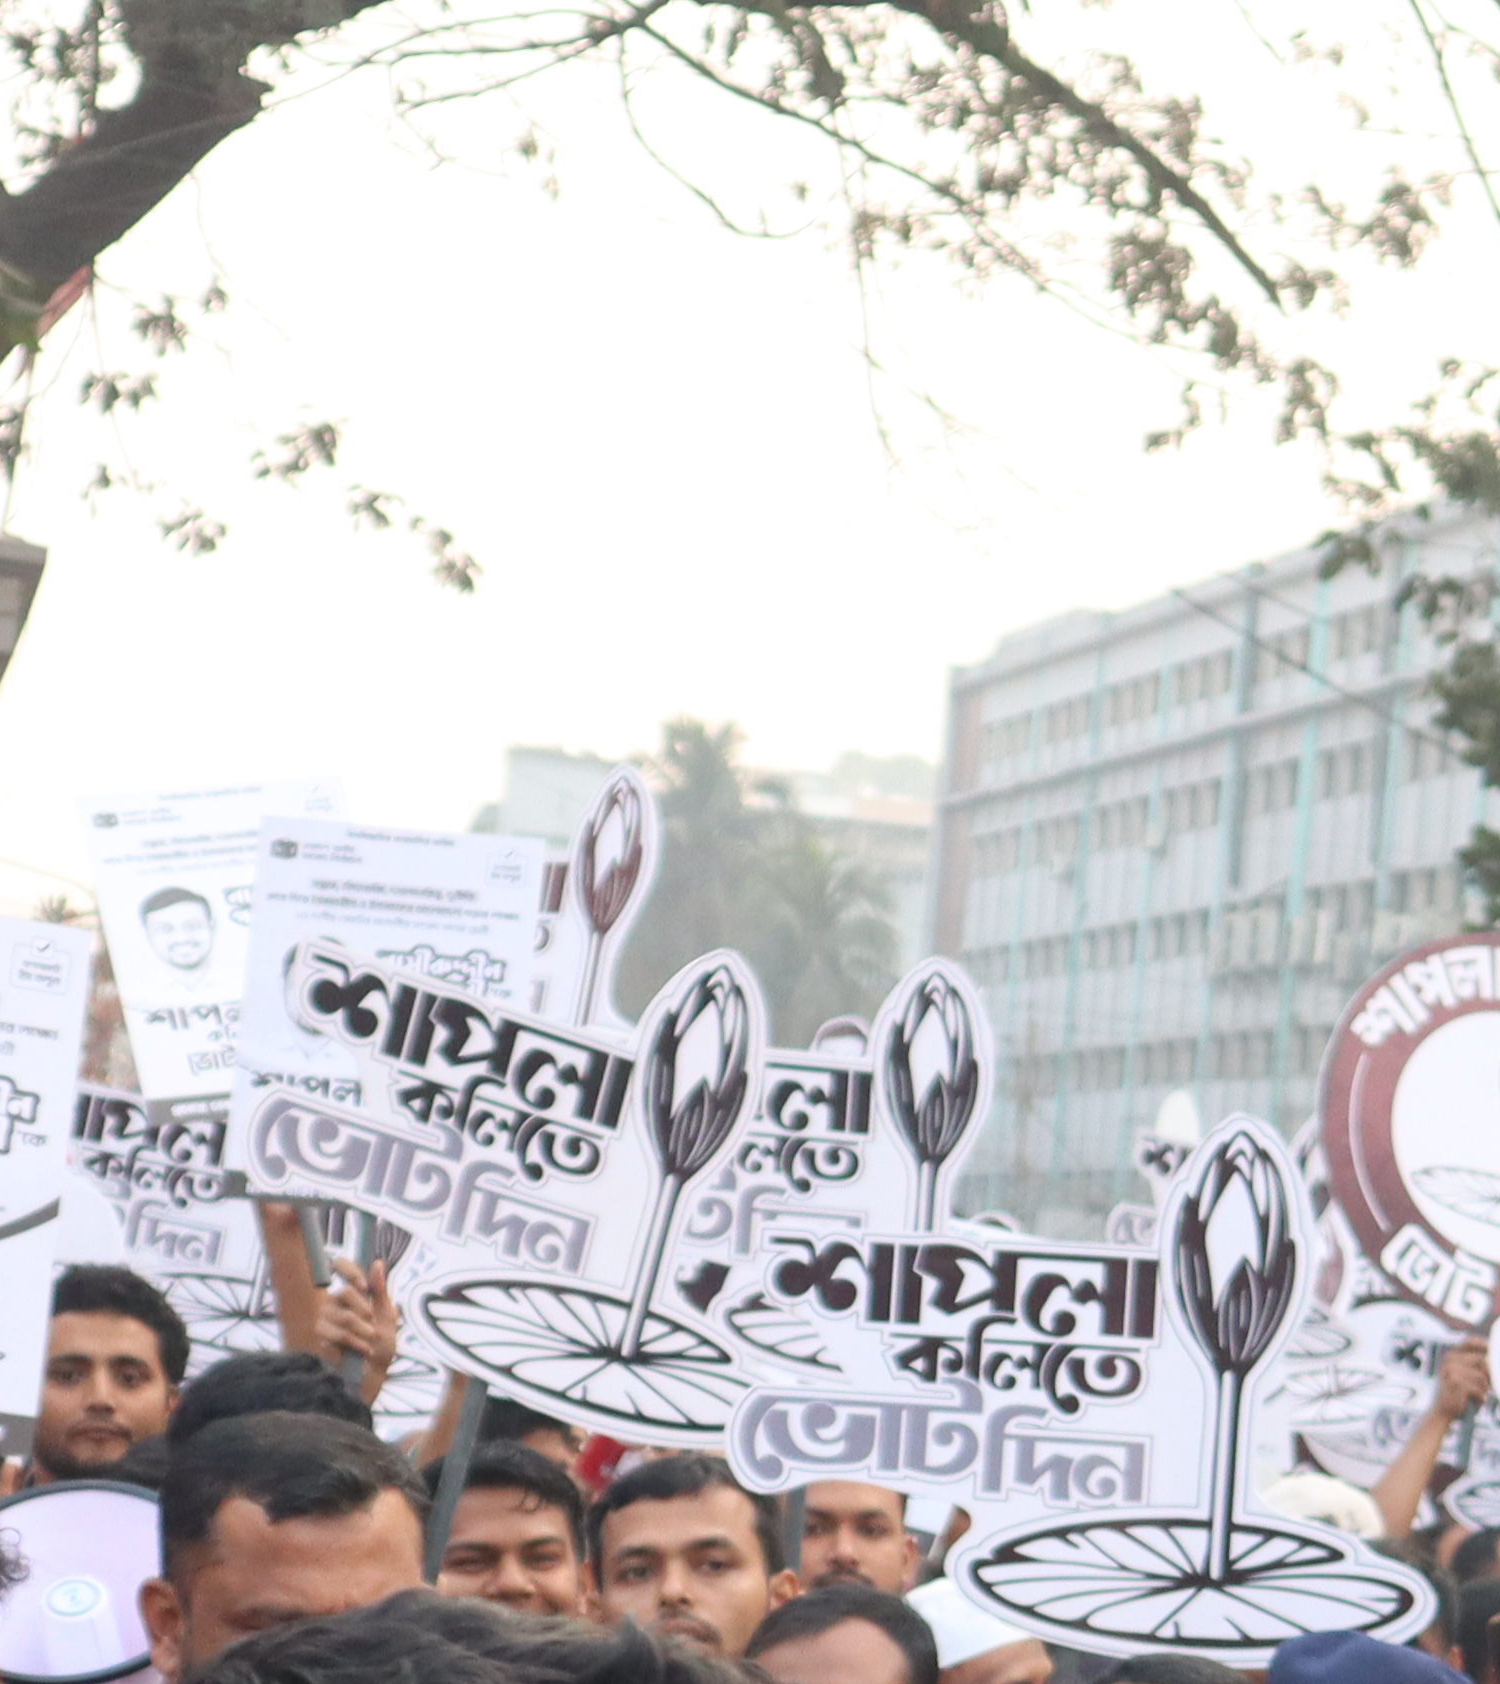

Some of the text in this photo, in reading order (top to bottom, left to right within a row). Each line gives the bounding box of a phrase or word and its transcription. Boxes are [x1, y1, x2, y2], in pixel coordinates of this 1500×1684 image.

[311, 952, 634, 1131] শাপলা
[82, 1145, 227, 1208] কলিতে
[397, 1070, 603, 1181] কলিতে
[769, 1236, 1159, 1339] শাপলা
[1380, 1223, 1496, 1326] ভোট
[889, 1314, 1142, 1415] কলিতে
